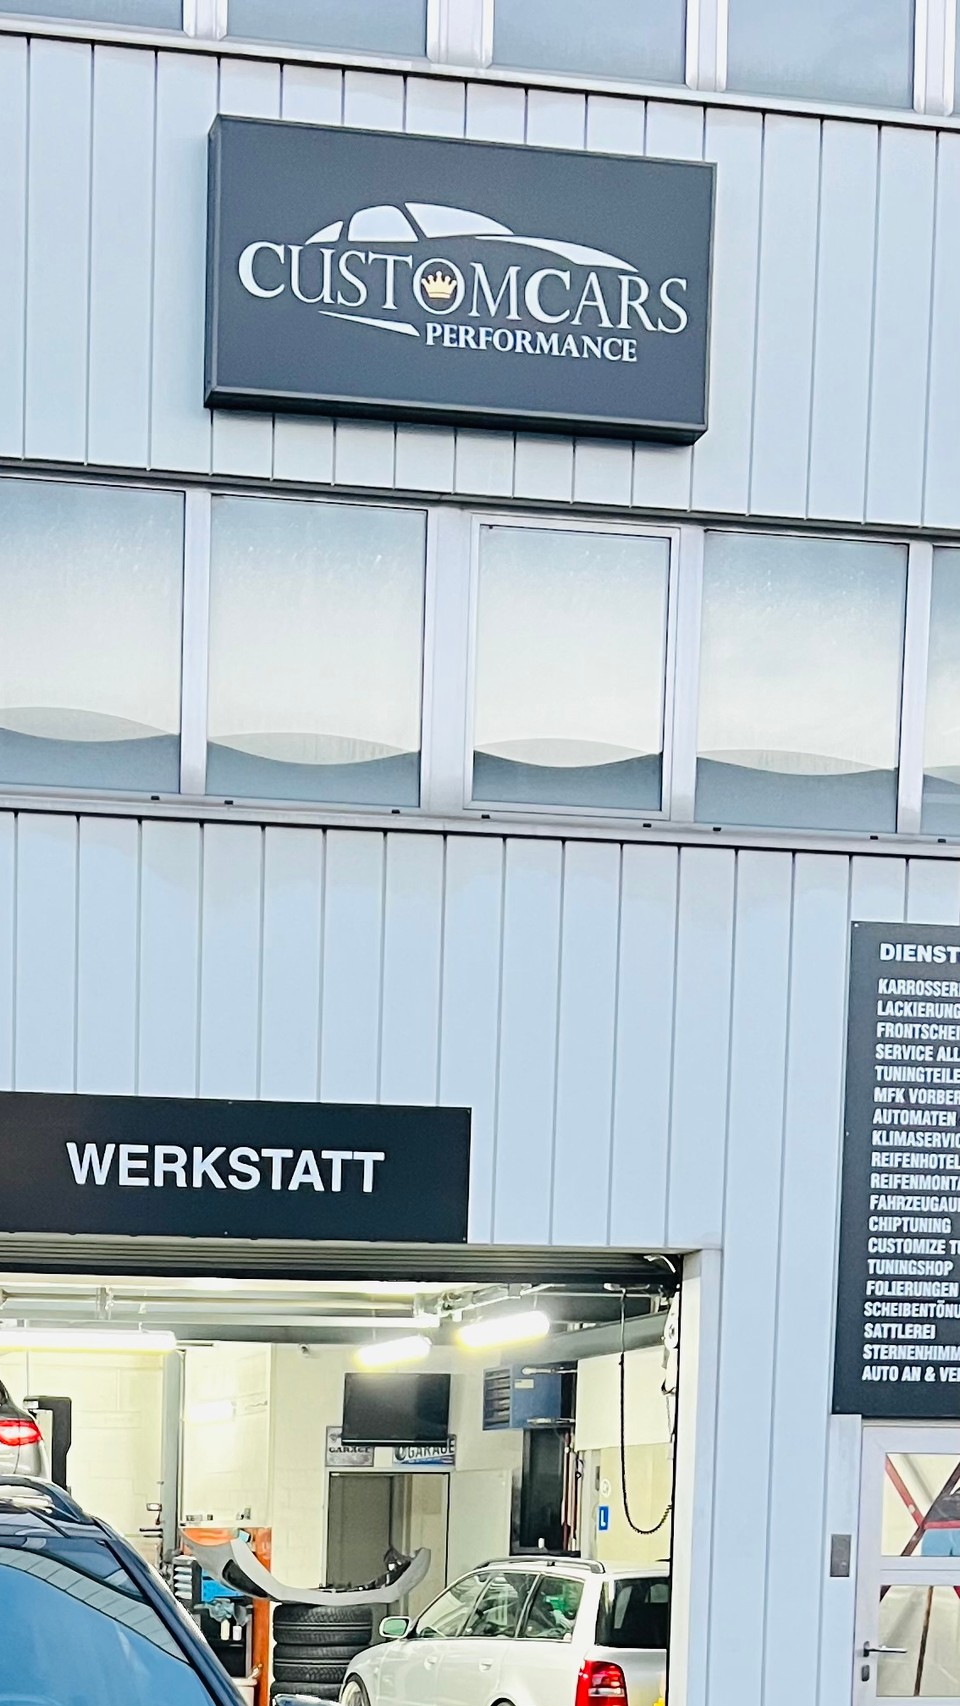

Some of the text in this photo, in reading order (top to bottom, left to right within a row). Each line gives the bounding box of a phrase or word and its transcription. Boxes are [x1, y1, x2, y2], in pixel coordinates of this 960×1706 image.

[239, 241, 688, 334] CUSTOMCARS
[427, 323, 637, 362] PERFORMANCE
[880, 943, 960, 963] DIENST
[878, 978, 960, 997] KARROSSER
[877, 1000, 960, 1018] LACKIERUNG
[875, 1044, 960, 1062] SERVICE ALL
[875, 1065, 960, 1083] TUNINGTEILE
[874, 1087, 905, 1103] MFK
[873, 1109, 956, 1126] AUTOMATEN
[66, 1141, 385, 1193] WERKSTATT
[872, 1152, 960, 1170] REIFENHOTEL
[870, 1195, 960, 1213] FAHRZEUGAU
[869, 1217, 952, 1234] CHIPTUNING
[868, 1238, 946, 1255] CUSTOMIZE
[868, 1259, 954, 1277] TUNINGSHOP
[867, 1281, 959, 1298] FOLIERUNGEN
[864, 1323, 936, 1340] SATTLEREI
[862, 1366, 898, 1382] AUTO
[901, 1366, 921, 1381] AN
[924, 1366, 936, 1382] &
